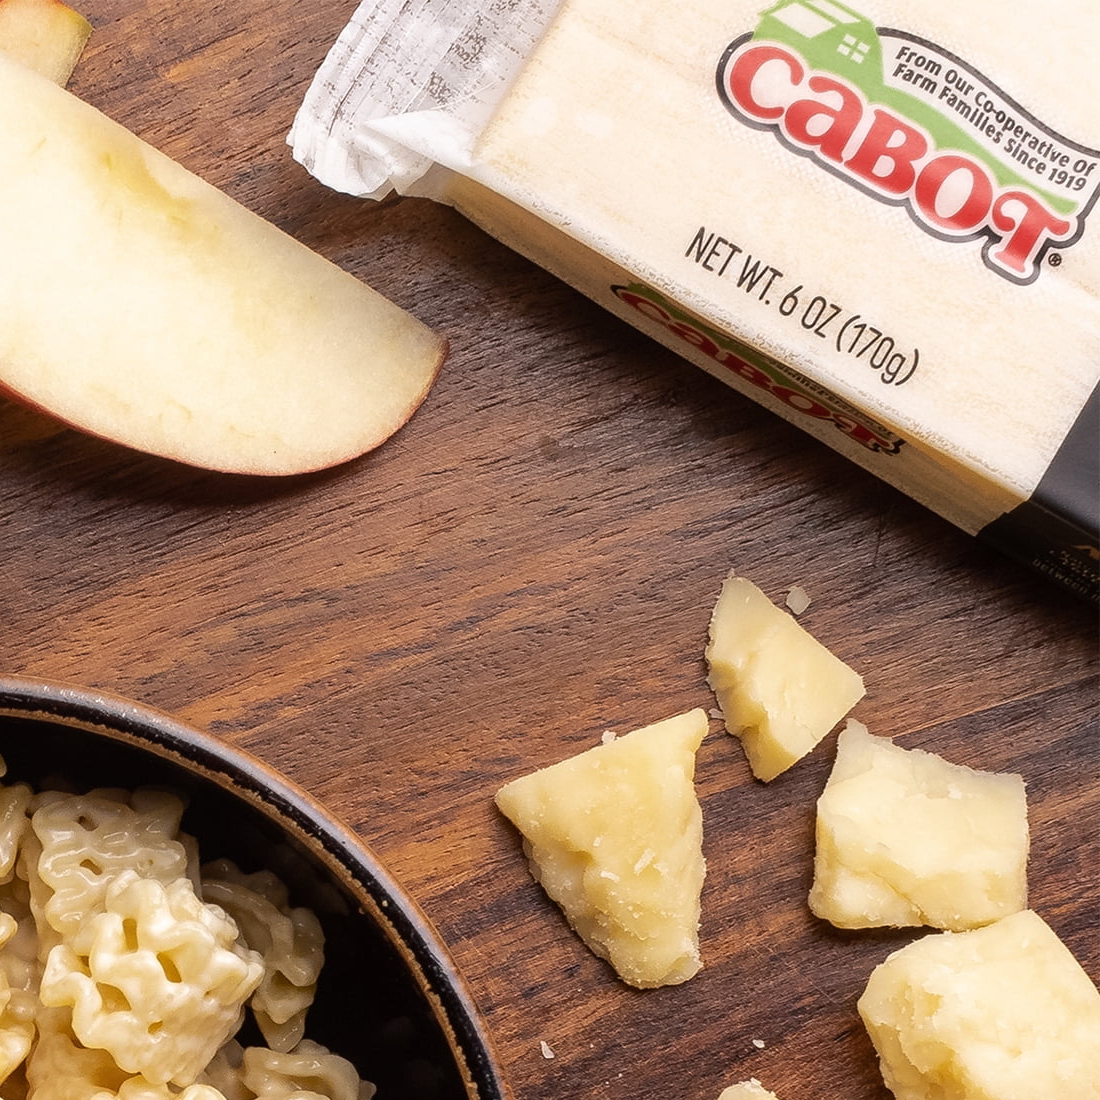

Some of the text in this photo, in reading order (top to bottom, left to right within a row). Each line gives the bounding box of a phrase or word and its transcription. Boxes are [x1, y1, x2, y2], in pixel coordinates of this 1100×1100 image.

[892, 63, 1087, 192] Farm Families Since 1919
[895, 46, 1098, 177] From Our Co-operative Of
[685, 226, 920, 386] NET WT. 6 OZ (170g)
